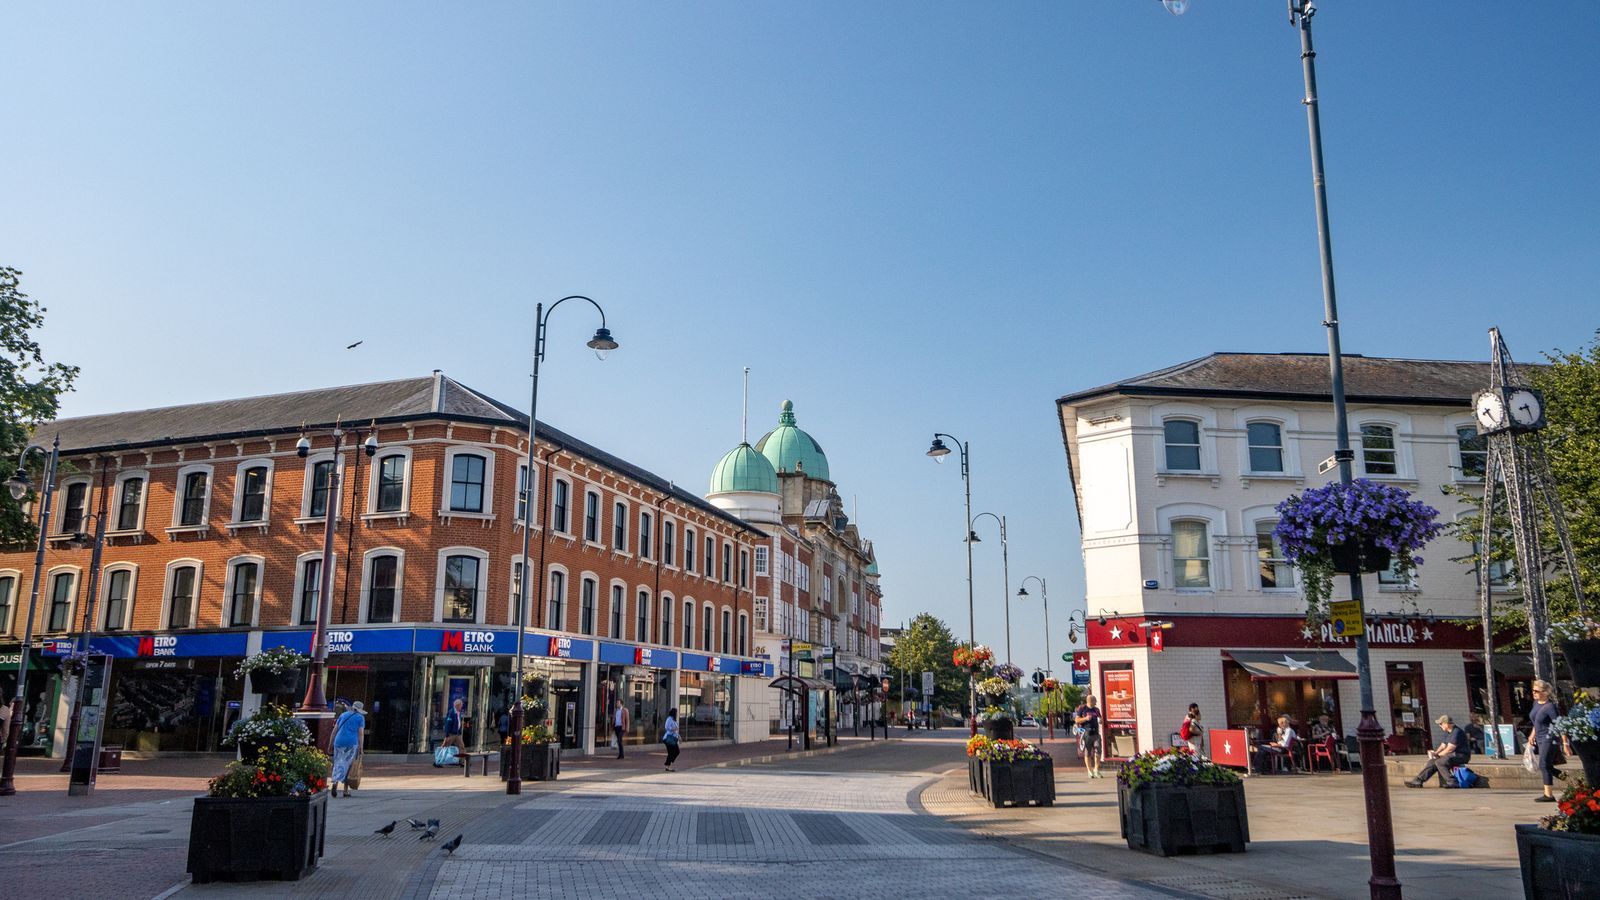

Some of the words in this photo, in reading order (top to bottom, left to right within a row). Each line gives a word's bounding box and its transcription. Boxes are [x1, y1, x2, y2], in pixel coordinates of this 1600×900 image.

[1321, 622, 1349, 643] PR
[1366, 623, 1415, 643] MANGER
[441, 631, 495, 652] METRO
[138, 636, 177, 657] METRO
[328, 643, 352, 652] BANK
[464, 643, 493, 652] BANK
[548, 637, 571, 657] METRO
[153, 648, 175, 656] BANK
[558, 649, 571, 657] BANK
[463, 657, 470, 665] 7
